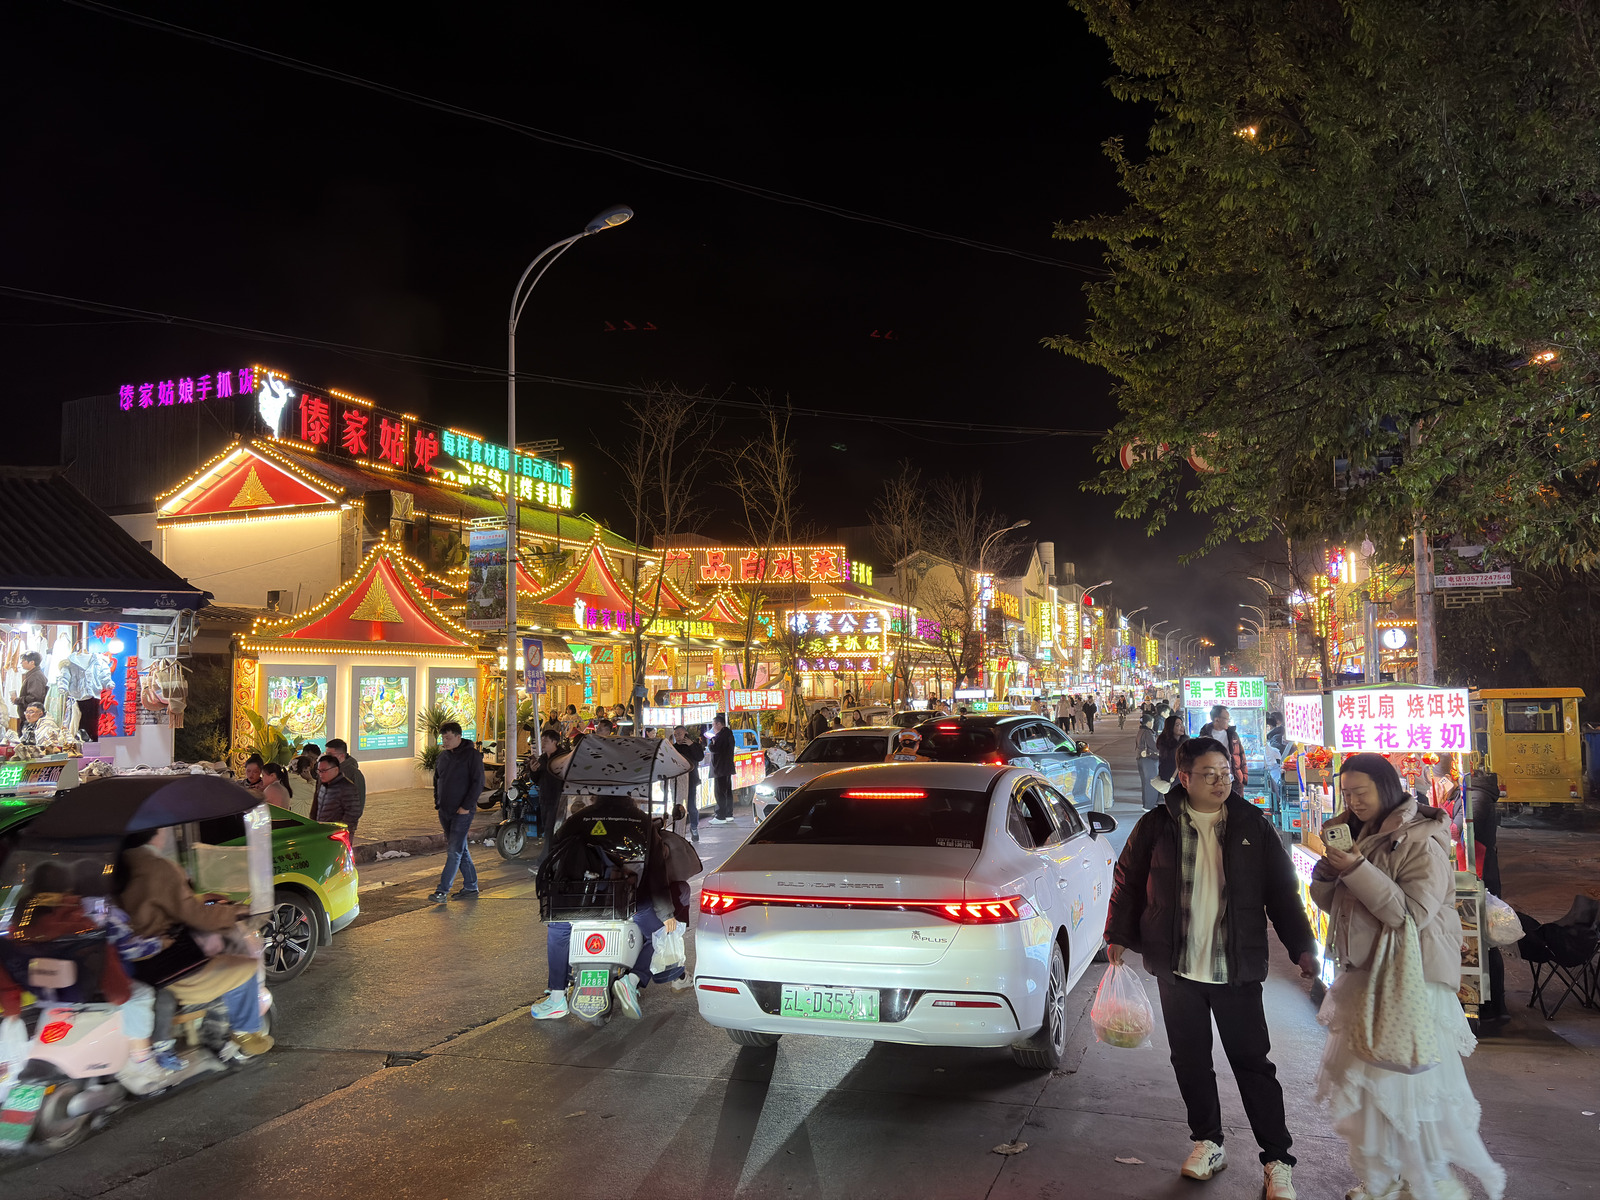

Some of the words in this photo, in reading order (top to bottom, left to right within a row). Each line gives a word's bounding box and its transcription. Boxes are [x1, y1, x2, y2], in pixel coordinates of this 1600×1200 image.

[119, 368, 253, 410] 傣家姑娘手抓饭
[299, 393, 439, 476] 傣家姑娘
[1338, 694, 1394, 719] 烤乳扇
[1407, 693, 1465, 718] 烧饵块
[1340, 723, 1465, 749] 鲜花烤奶
[0, 766, 23, 787] 空车
